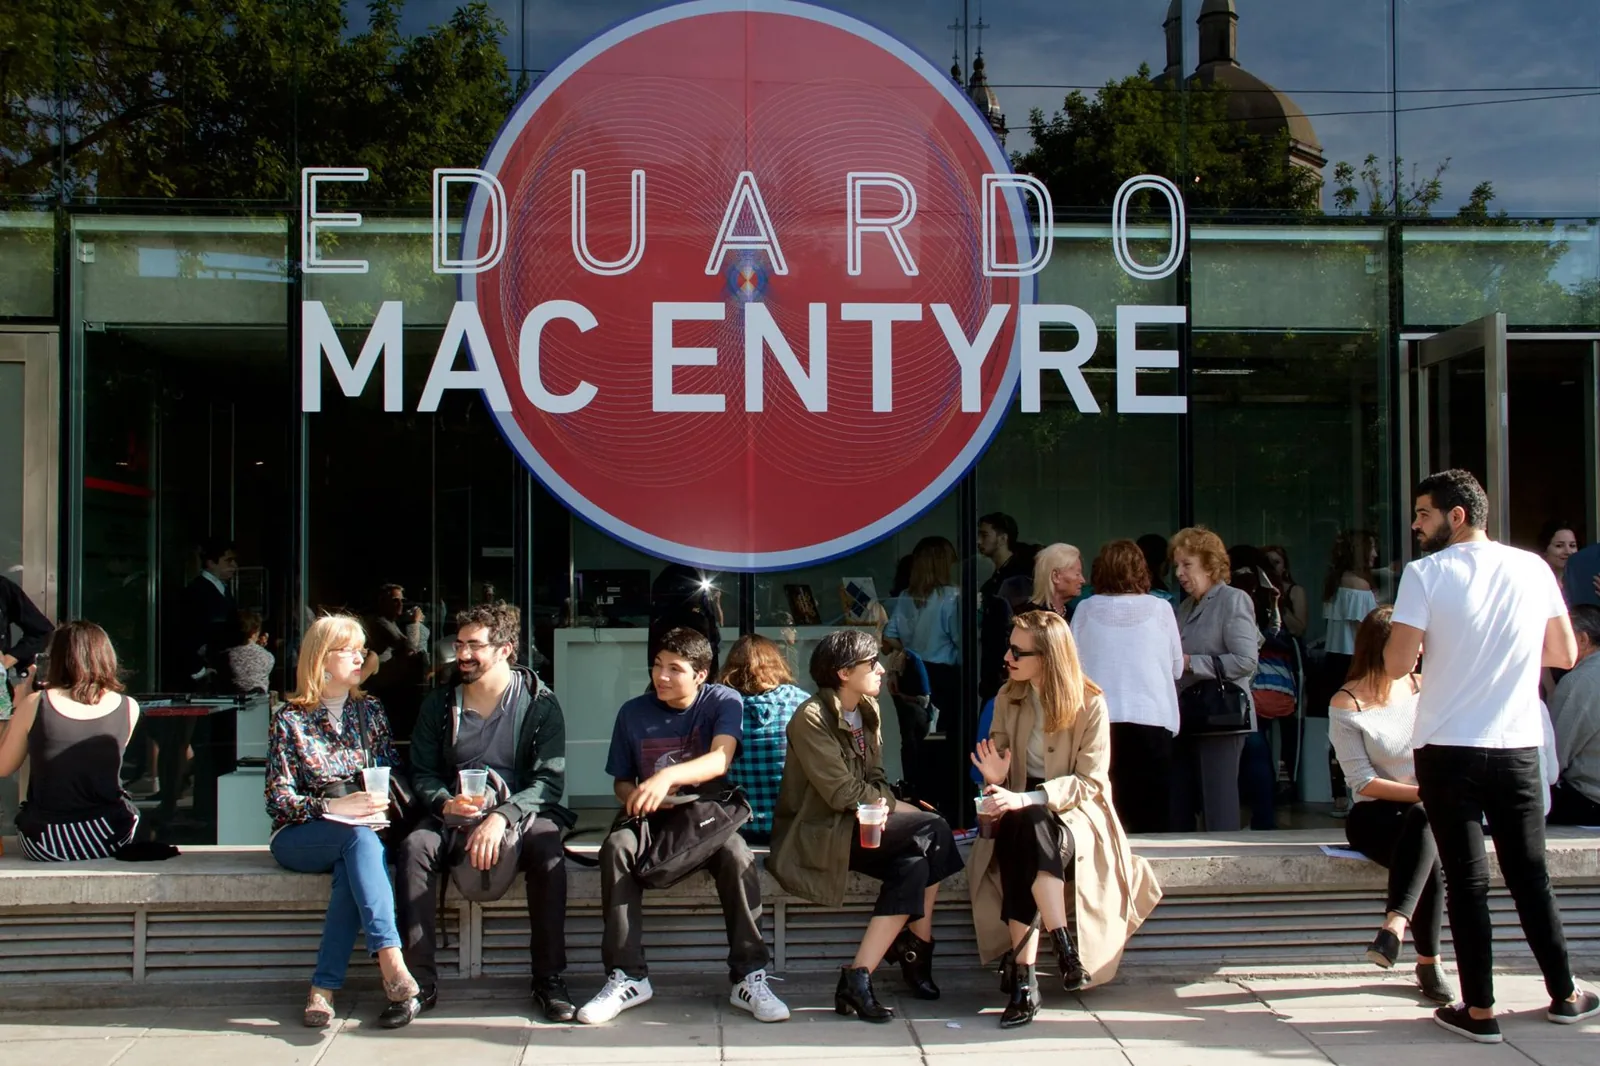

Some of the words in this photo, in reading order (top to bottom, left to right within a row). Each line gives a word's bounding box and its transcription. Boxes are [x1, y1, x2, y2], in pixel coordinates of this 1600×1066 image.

[302, 168, 1186, 280] EDUARDO
[302, 300, 598, 414] MAC
[652, 302, 1187, 414] ENTYRE
